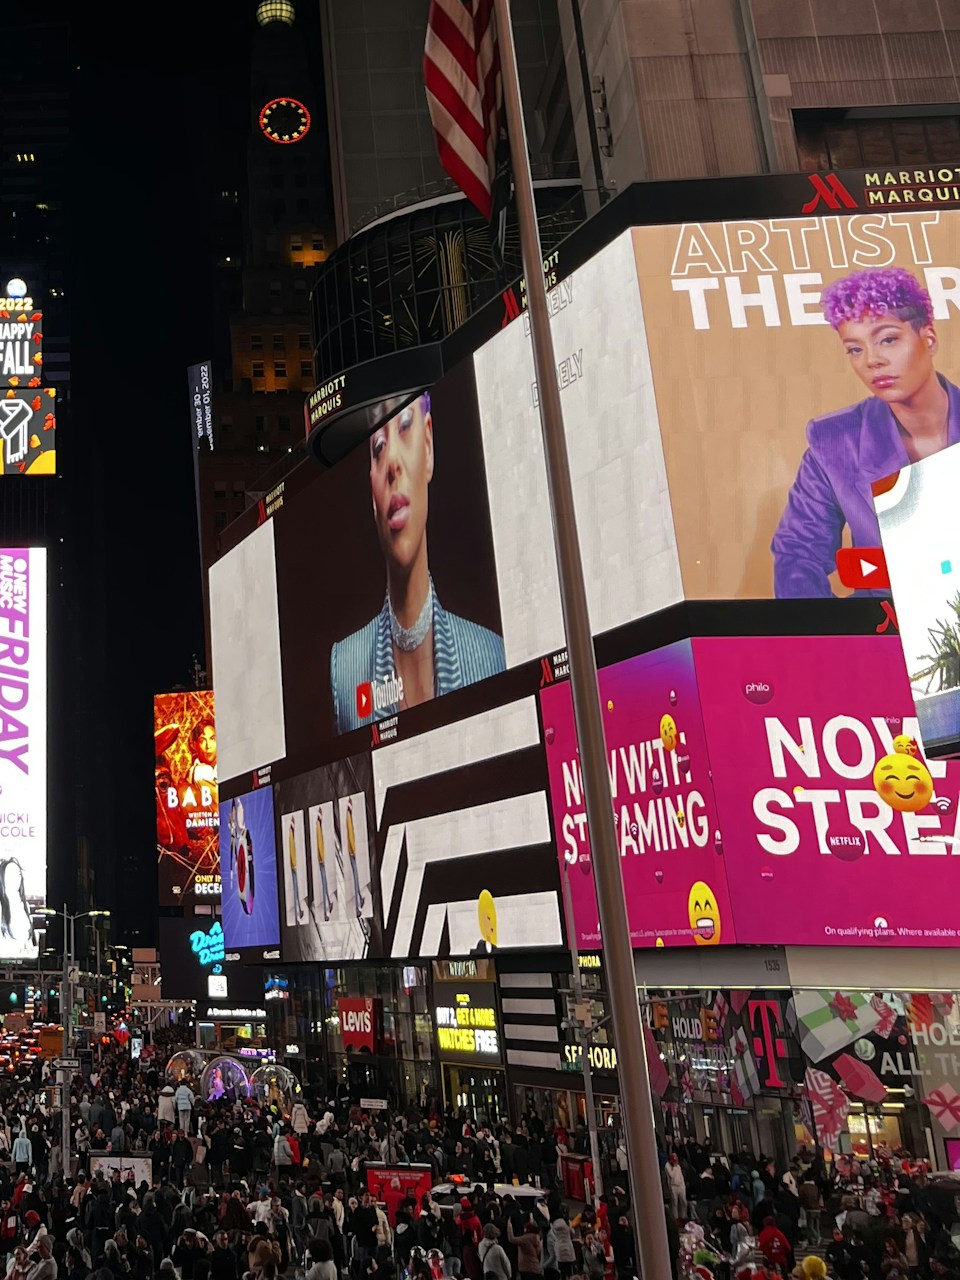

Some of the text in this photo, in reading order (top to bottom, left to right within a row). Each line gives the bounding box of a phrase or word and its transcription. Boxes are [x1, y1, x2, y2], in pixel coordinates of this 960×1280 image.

[670, 211, 940, 276] ARTIST
[671, 273, 831, 330] THE
[201, 365, 209, 389] 2022
[309, 375, 346, 409] MARRIOTT
[310, 394, 342, 424] MARQUIS
[0, 553, 15, 610] MUSIC
[14, 571, 28, 615] NEW
[371, 670, 404, 711] YouTube
[746, 682, 770, 694] philo
[186, 818, 221, 829] DAMIEN
[562, 790, 710, 864] STAMING
[753, 787, 960, 856] STRE
[830, 836, 861, 846] NETFLIX
[195, 874, 214, 883] ONLY
[195, 883, 222, 894] DECE
[825, 926, 956, 937] On qualifying plans. Where available
[577, 955, 601, 969] PHORA
[437, 1027, 499, 1054] WATCHES FREE
[672, 1016, 703, 1039] HOLID
